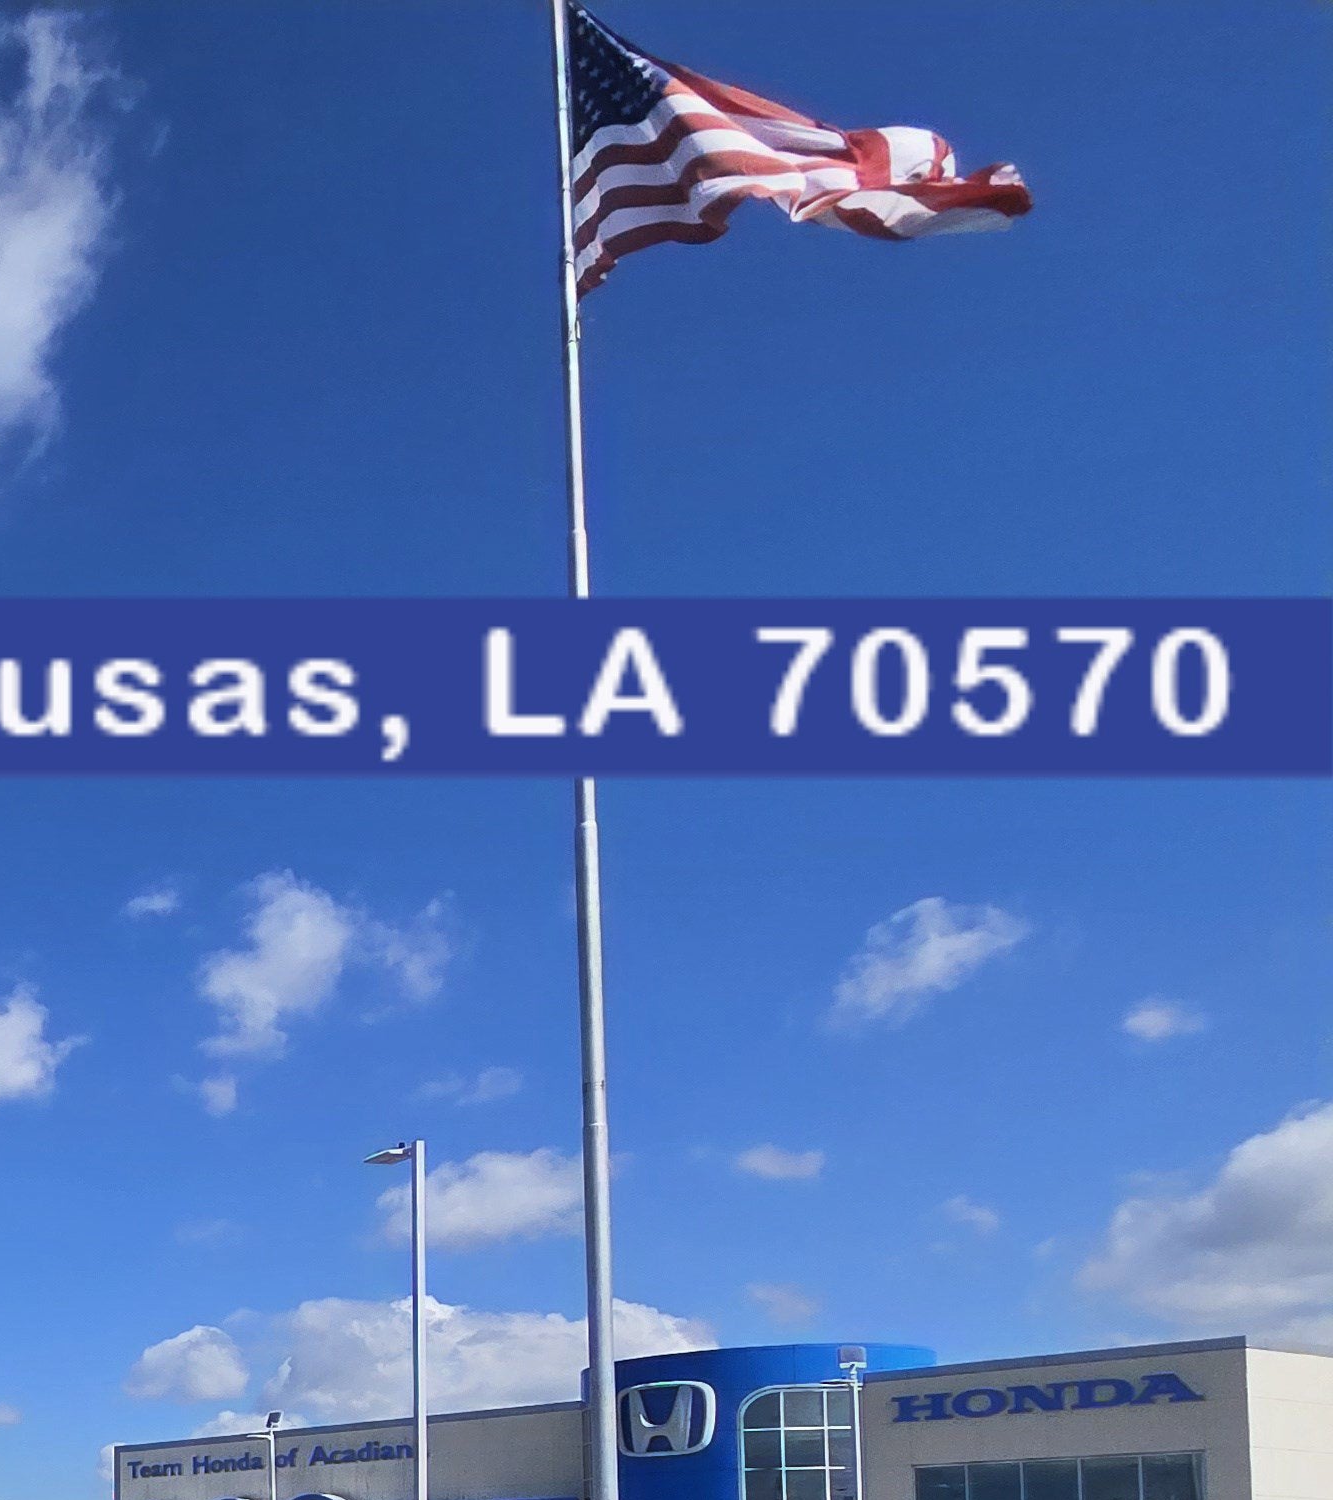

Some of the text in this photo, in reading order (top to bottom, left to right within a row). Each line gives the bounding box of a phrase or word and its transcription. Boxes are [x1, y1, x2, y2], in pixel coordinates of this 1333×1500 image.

[891, 1372, 1206, 1422] HONDA
[127, 1441, 418, 1479] Team Honda of Acadian
